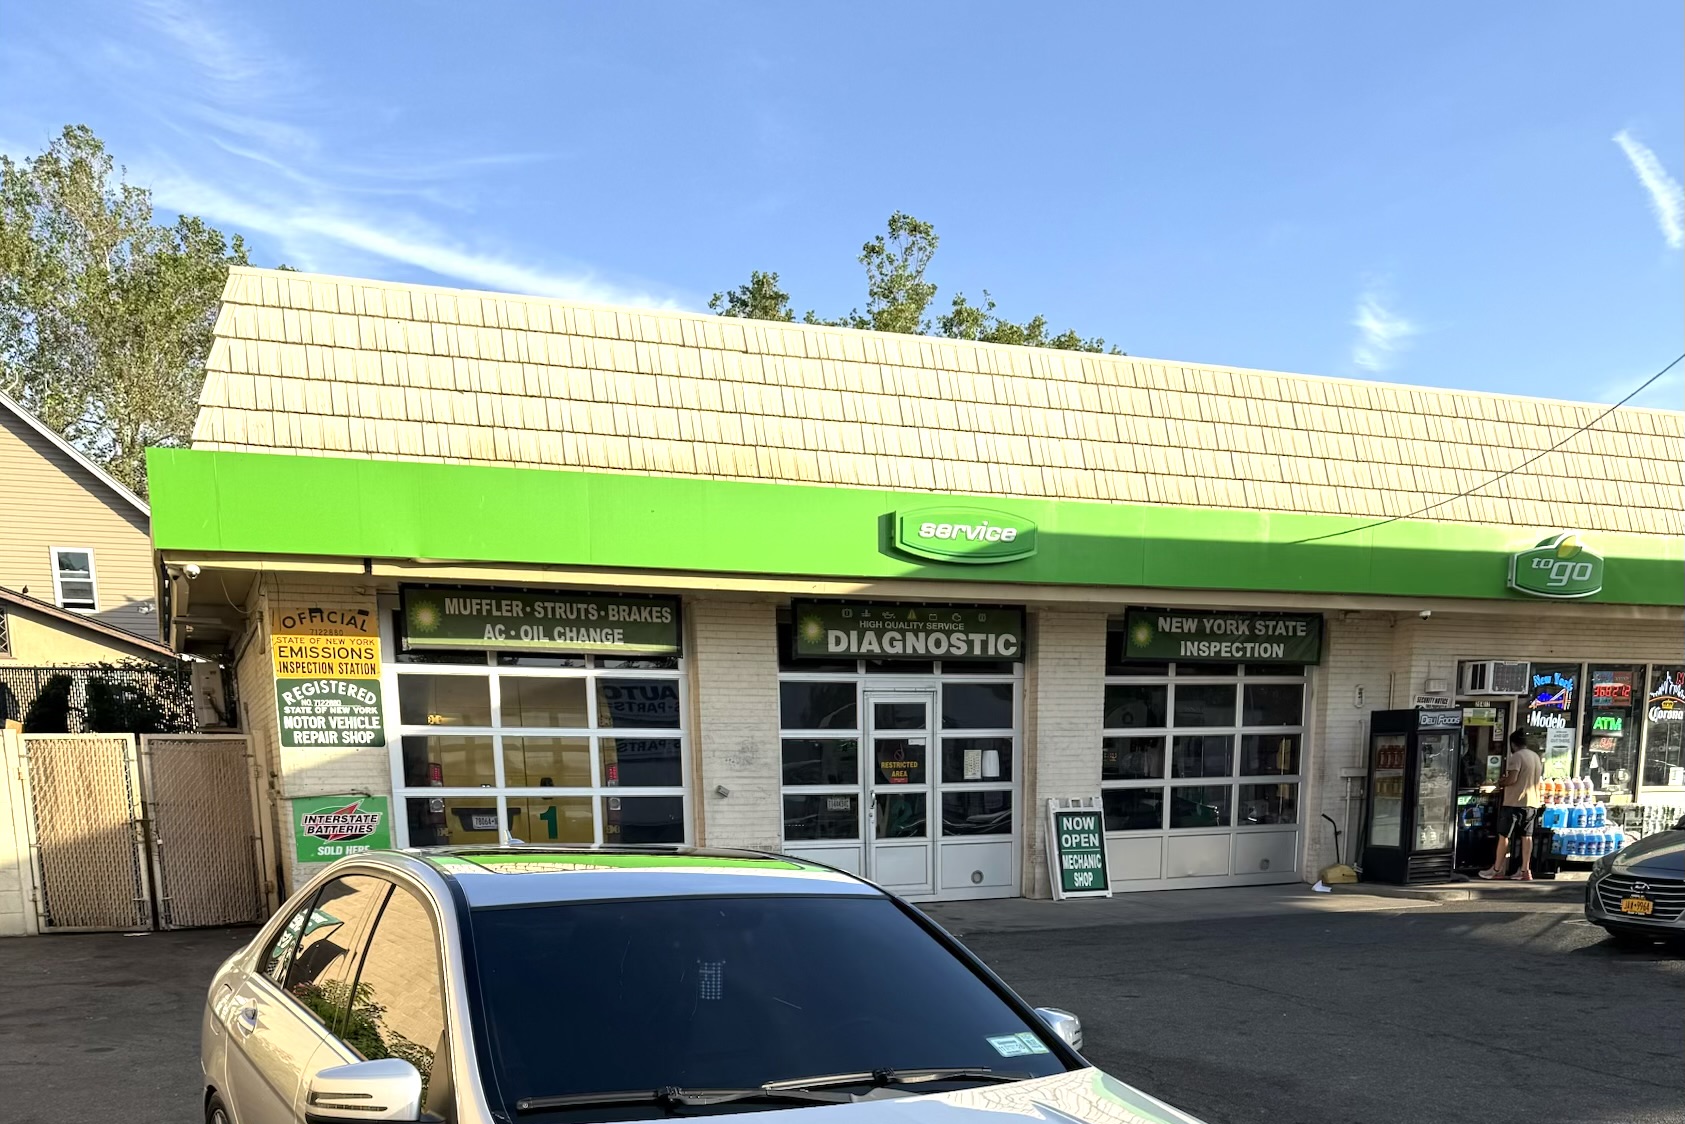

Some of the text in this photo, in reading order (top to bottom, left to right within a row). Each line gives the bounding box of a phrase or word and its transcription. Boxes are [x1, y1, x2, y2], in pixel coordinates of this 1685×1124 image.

[918, 521, 1017, 542] service
[1532, 557, 1554, 569] to
[1546, 561, 1593, 586] go
[445, 598, 672, 623] MUFFLER STRUTS BRAKES
[282, 611, 367, 632] OFFICIAL
[859, 620, 965, 630] HIGH QUALITY SERVICE
[1158, 616, 1307, 636] NEW YORK STATE
[276, 636, 305, 644] STATE
[309, 637, 322, 645] OF
[350, 638, 375, 646] YORK
[483, 623, 625, 644] AC OIL CHANGE
[827, 629, 1018, 656] DIAGNOSTIC
[1180, 640, 1285, 658] INSPECTION
[278, 646, 375, 660] EMISSIONS
[279, 661, 376, 675] INSPECTION STATION
[282, 680, 377, 705] REGISTERED
[283, 706, 312, 714] STATE
[1648, 706, 1684, 723] Corona
[283, 716, 381, 729] MOTOR VEHICLE
[1530, 710, 1566, 729] Modelo
[1593, 716, 1622, 731] ATM
[293, 731, 375, 744] REPAIR SHOP
[304, 814, 378, 823] INTERSTATE
[540, 806, 557, 839] 1
[1063, 816, 1095, 831] NOW
[307, 825, 373, 834] BATTERIES
[1061, 833, 1099, 848] OPEN
[317, 846, 343, 856] SOLD
[1062, 853, 1102, 870] MECHANIC
[1073, 871, 1094, 887] SHOP
